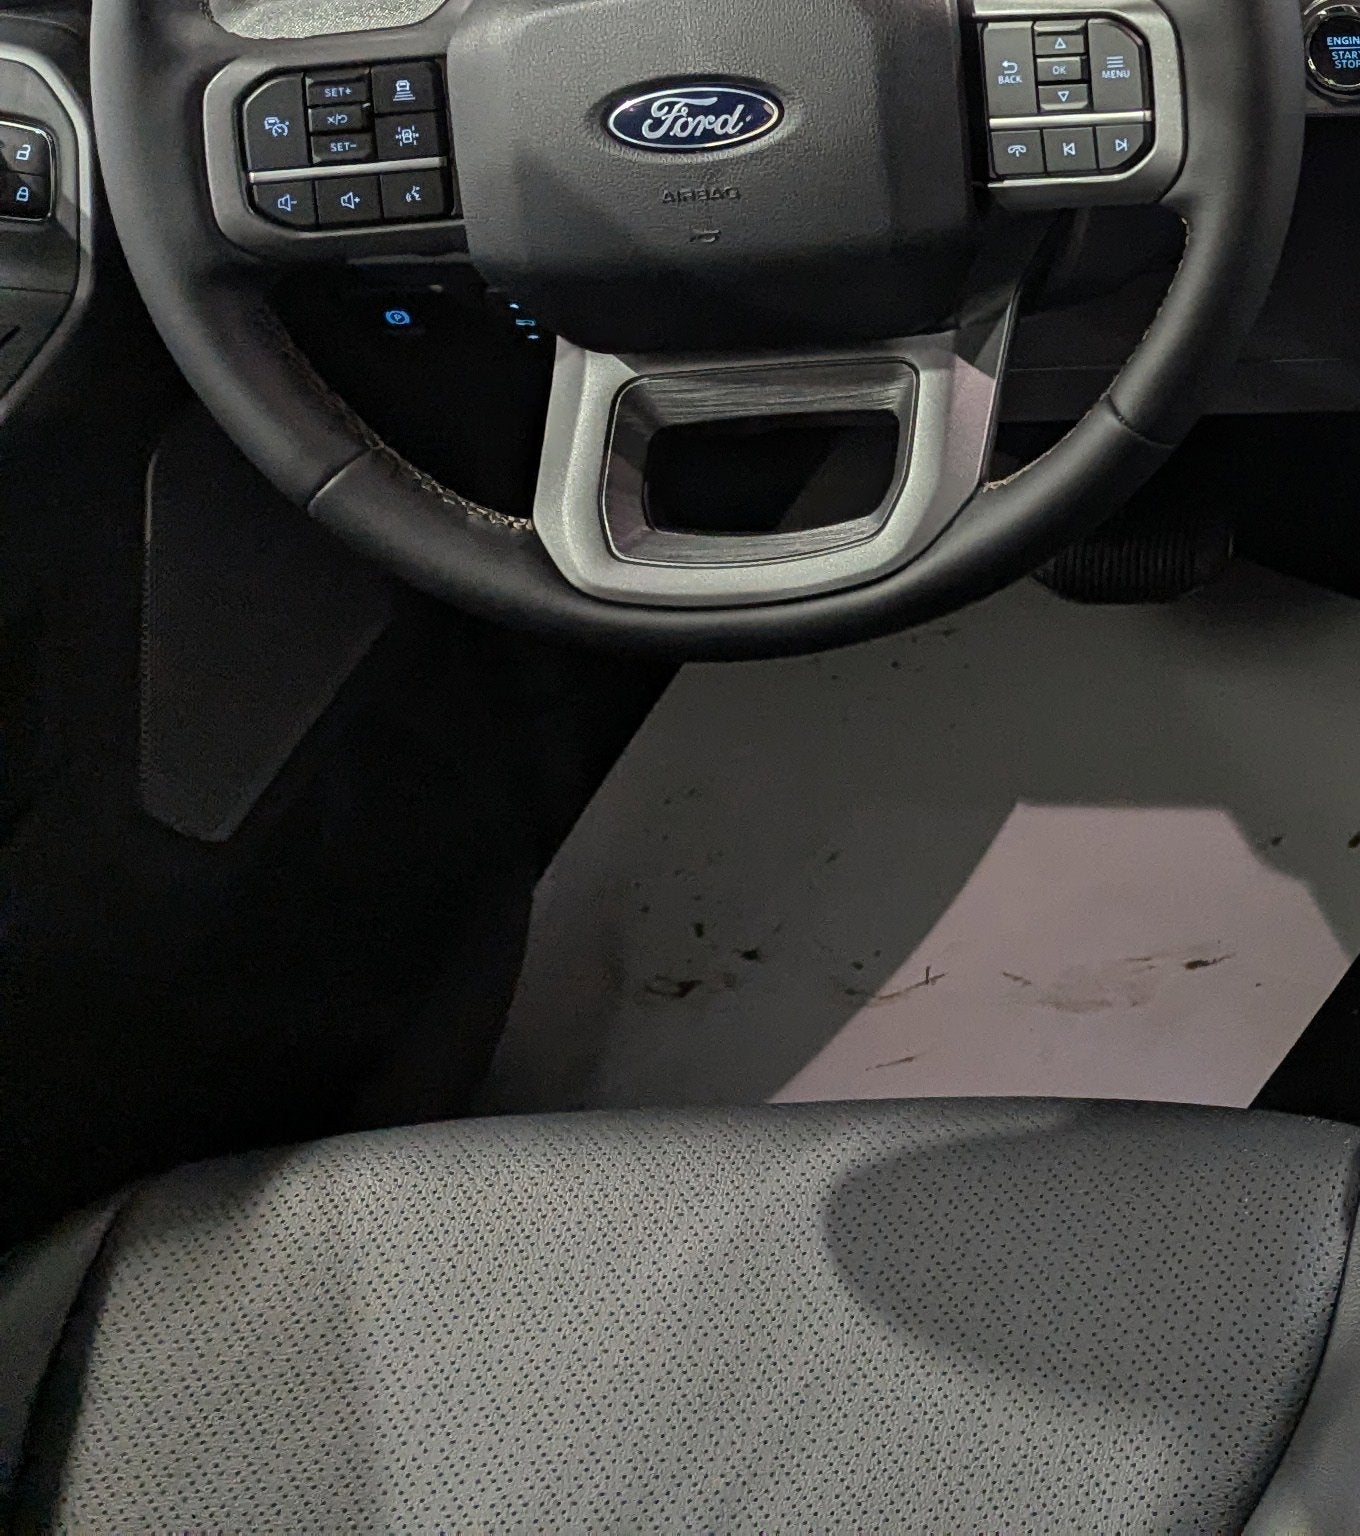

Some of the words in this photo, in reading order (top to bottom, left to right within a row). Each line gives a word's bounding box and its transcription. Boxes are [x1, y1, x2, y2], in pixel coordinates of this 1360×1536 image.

[1052, 66, 1067, 75] OK
[1101, 69, 1130, 79] MENU
[997, 75, 1022, 84] BACK
[324, 87, 352, 98] SET+
[641, 96, 745, 139] Ford
[662, 186, 741, 203] AIRBAG
